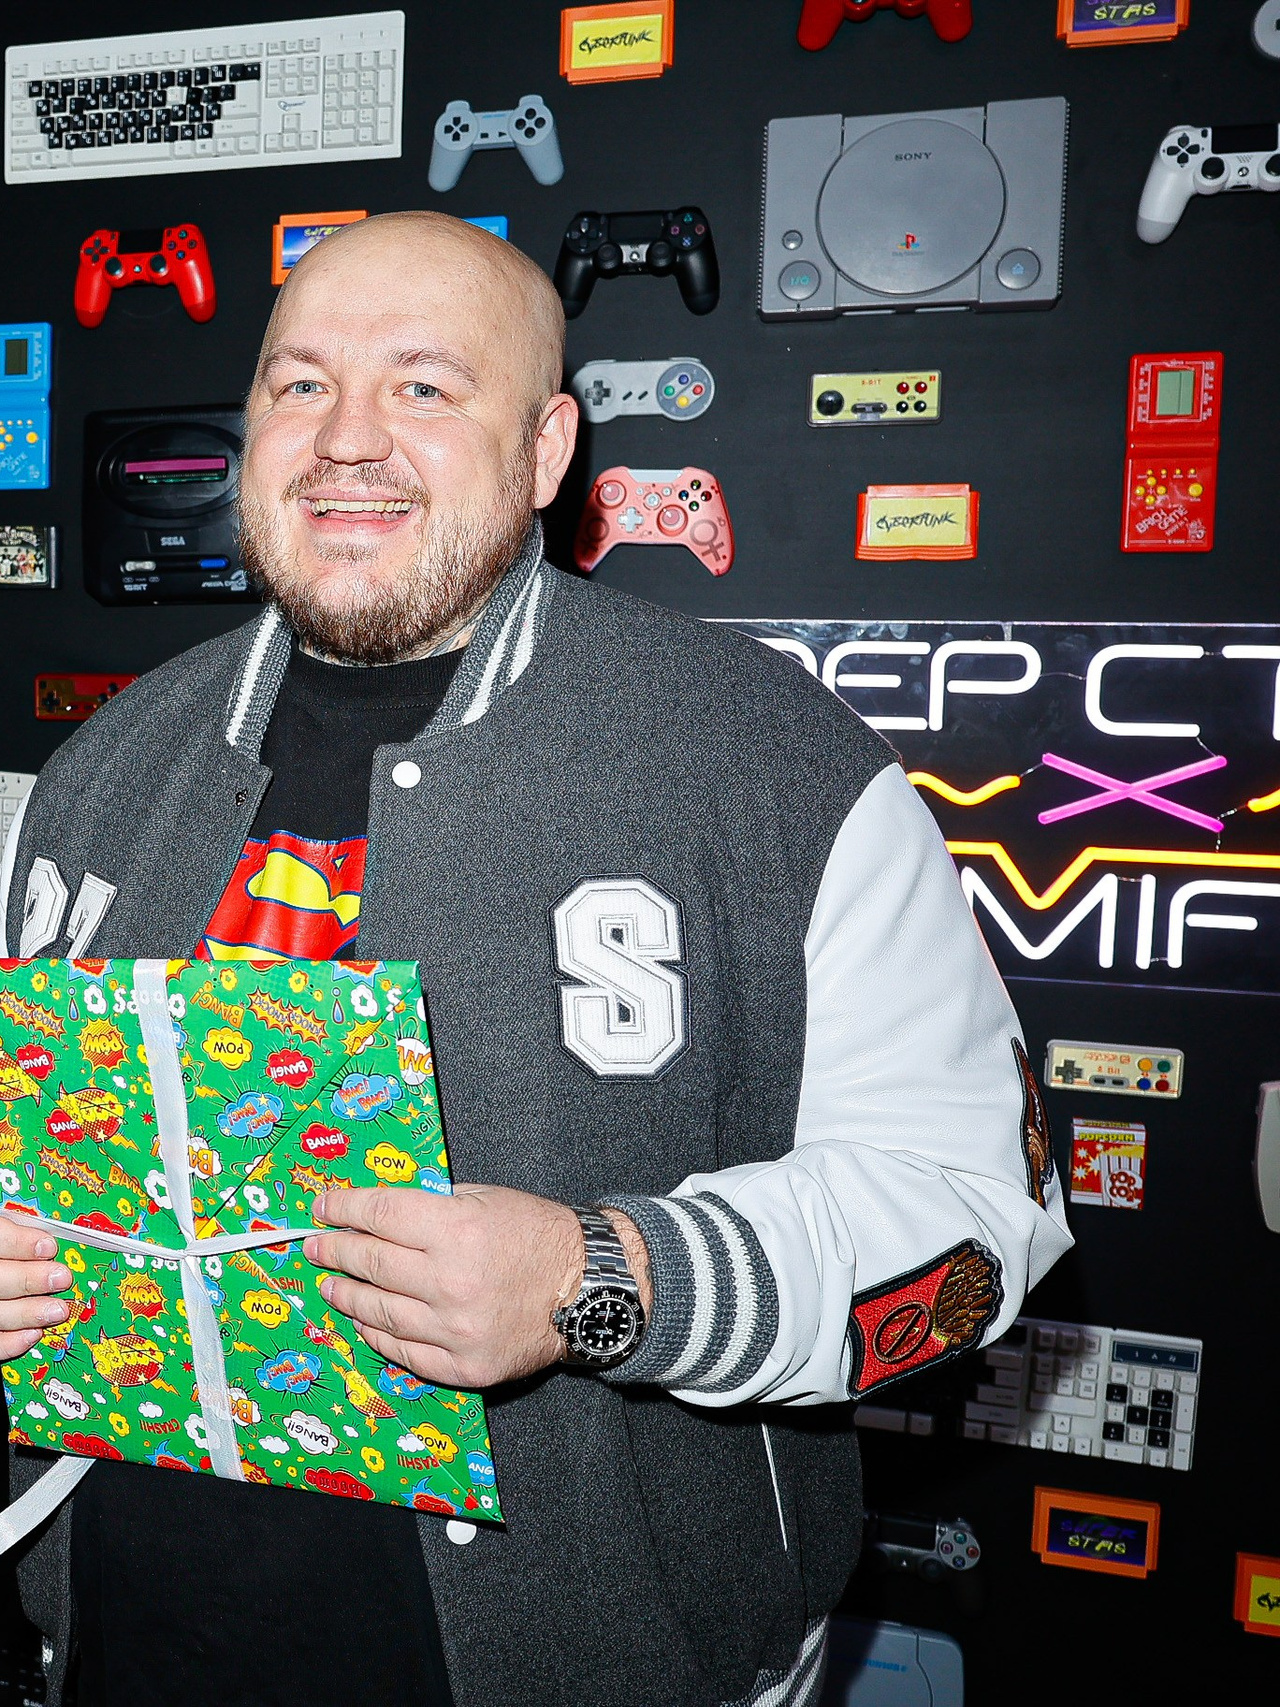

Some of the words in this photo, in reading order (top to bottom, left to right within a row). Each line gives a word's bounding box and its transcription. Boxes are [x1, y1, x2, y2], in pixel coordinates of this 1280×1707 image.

[894, 152, 932, 161] SONY
[160, 536, 185, 546] SEGA
[550, 876, 686, 1078] S
[190, 988, 245, 1028] BANG!
[85, 1033, 122, 1054] POW
[214, 1042, 243, 1055] POW
[1079, 1133, 1135, 1141] POPCORN
[373, 1155, 406, 1170] POW
[124, 1285, 161, 1305] POW
[251, 1302, 282, 1316] POW
[45, 1388, 82, 1412] BANG!!
[288, 1421, 329, 1447] BANG!!
[1068, 1535, 1126, 1555] STAS
